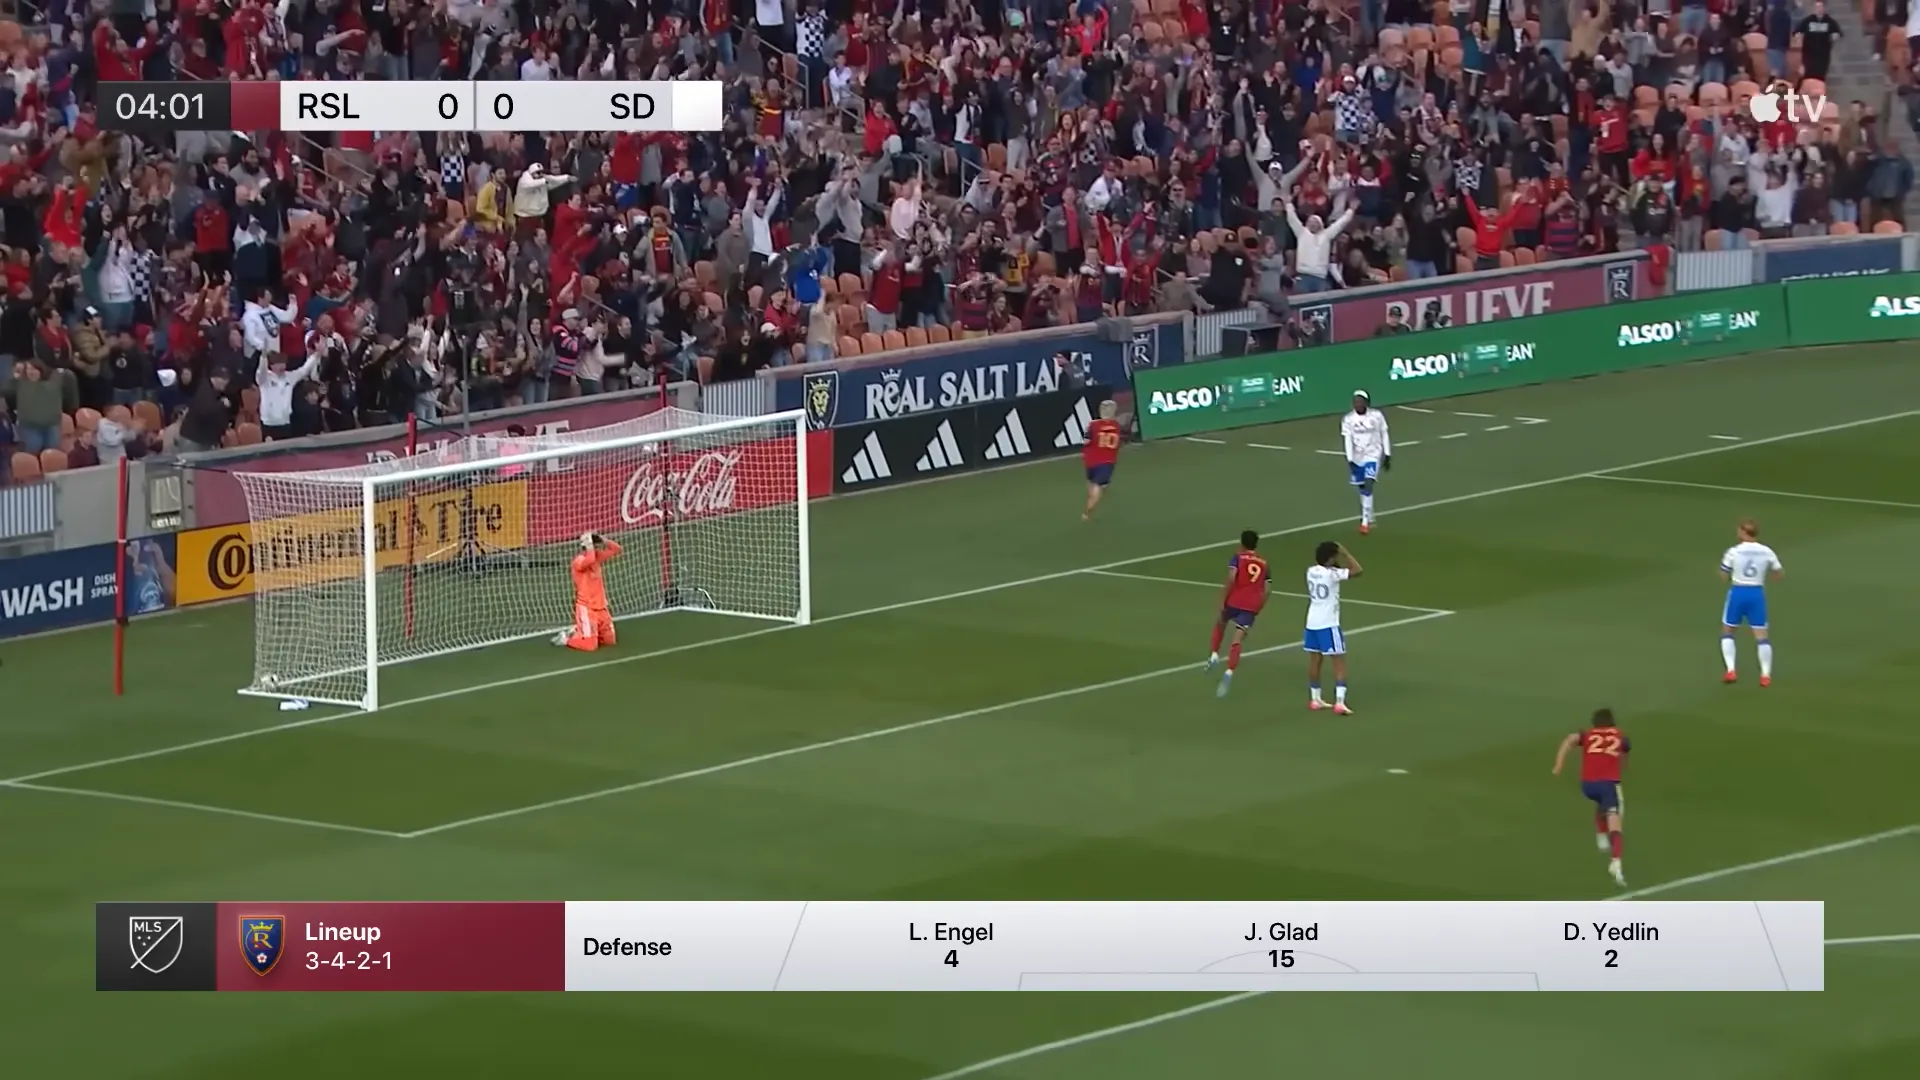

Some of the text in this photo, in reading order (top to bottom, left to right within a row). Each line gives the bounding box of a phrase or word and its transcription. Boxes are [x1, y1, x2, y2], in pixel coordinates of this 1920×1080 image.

[1618, 321, 1674, 346] ALSCO
[939, 363, 1009, 408] SALT
[1016, 351, 1098, 397] LAE
[1390, 353, 1449, 380] ALSCO
[1149, 386, 1212, 414] ALSCO
[621, 450, 744, 524] Coc-Cola
[94, 572, 116, 586] DISH
[1247, 563, 1262, 583] 9
[1742, 559, 1758, 578] 6
[1, 576, 85, 619] WASH
[1587, 734, 1622, 757] 22
